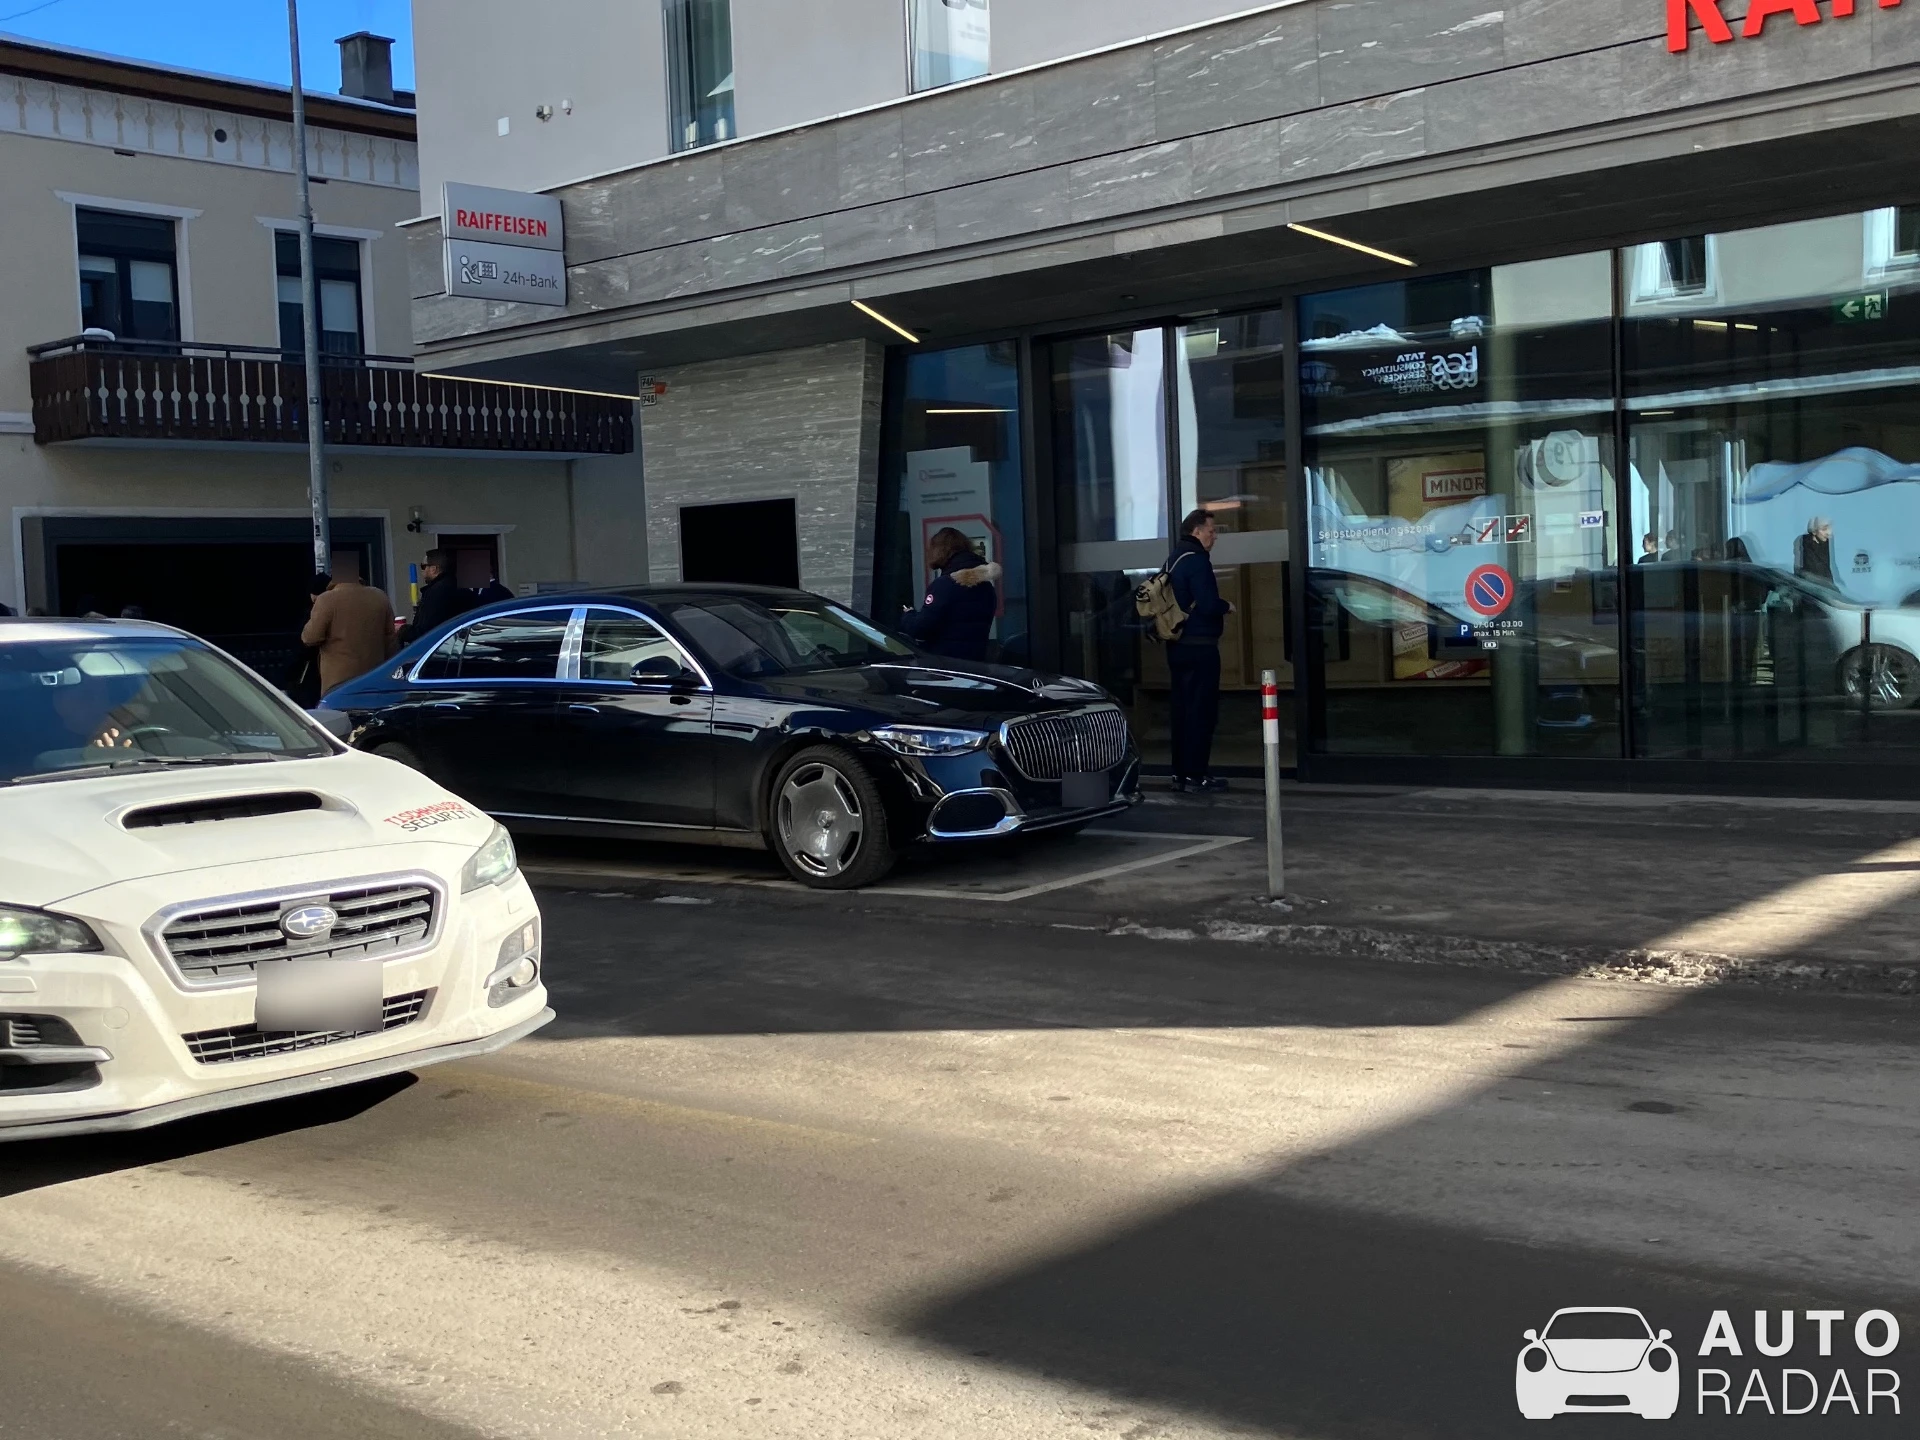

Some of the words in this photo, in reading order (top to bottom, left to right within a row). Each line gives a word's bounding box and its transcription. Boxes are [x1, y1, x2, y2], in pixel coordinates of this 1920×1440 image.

[457, 209, 547, 237] RAIFFEISEN
[503, 271, 558, 289] 24h-Bank
[1431, 477, 1485, 493] MINOR
[1460, 624, 1468, 636] P
[400, 810, 480, 832] SECURITY
